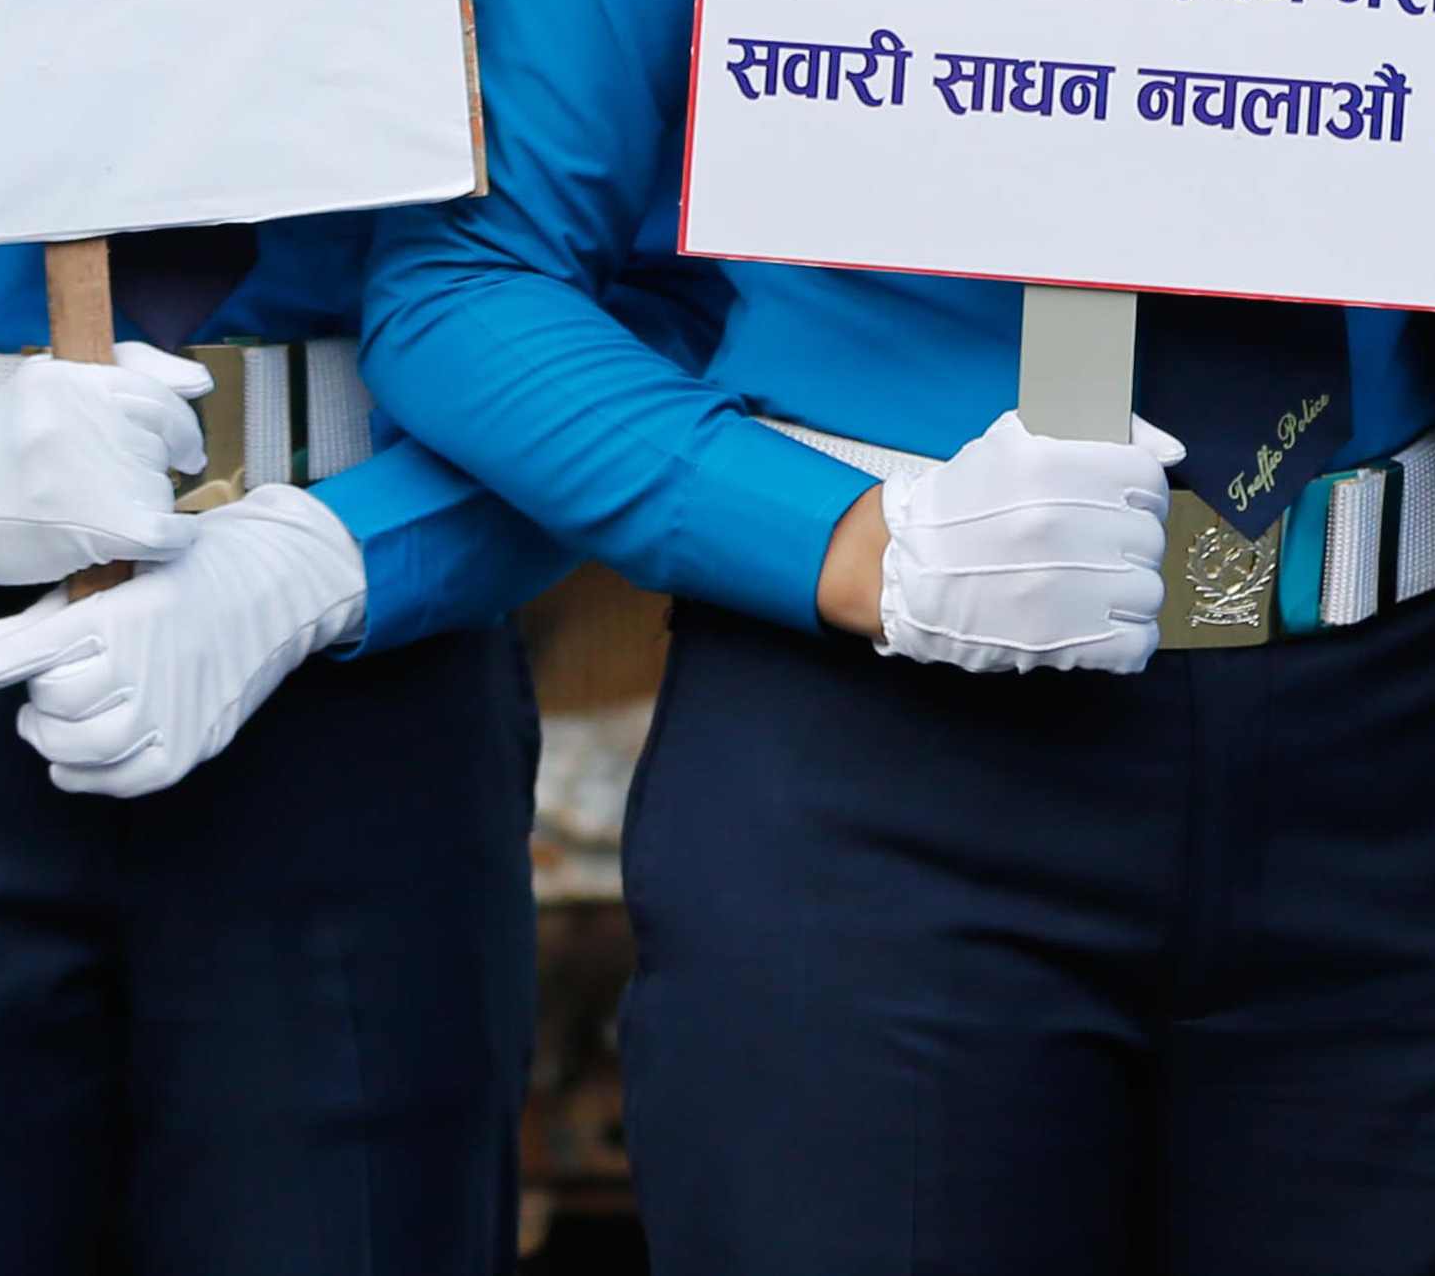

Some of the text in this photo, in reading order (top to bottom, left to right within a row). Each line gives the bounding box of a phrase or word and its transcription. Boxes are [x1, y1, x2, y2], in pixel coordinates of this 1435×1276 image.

[726, 28, 913, 108] सवारी
[932, 53, 1117, 121] साधन
[1228, 394, 1330, 512] Traffic Police
